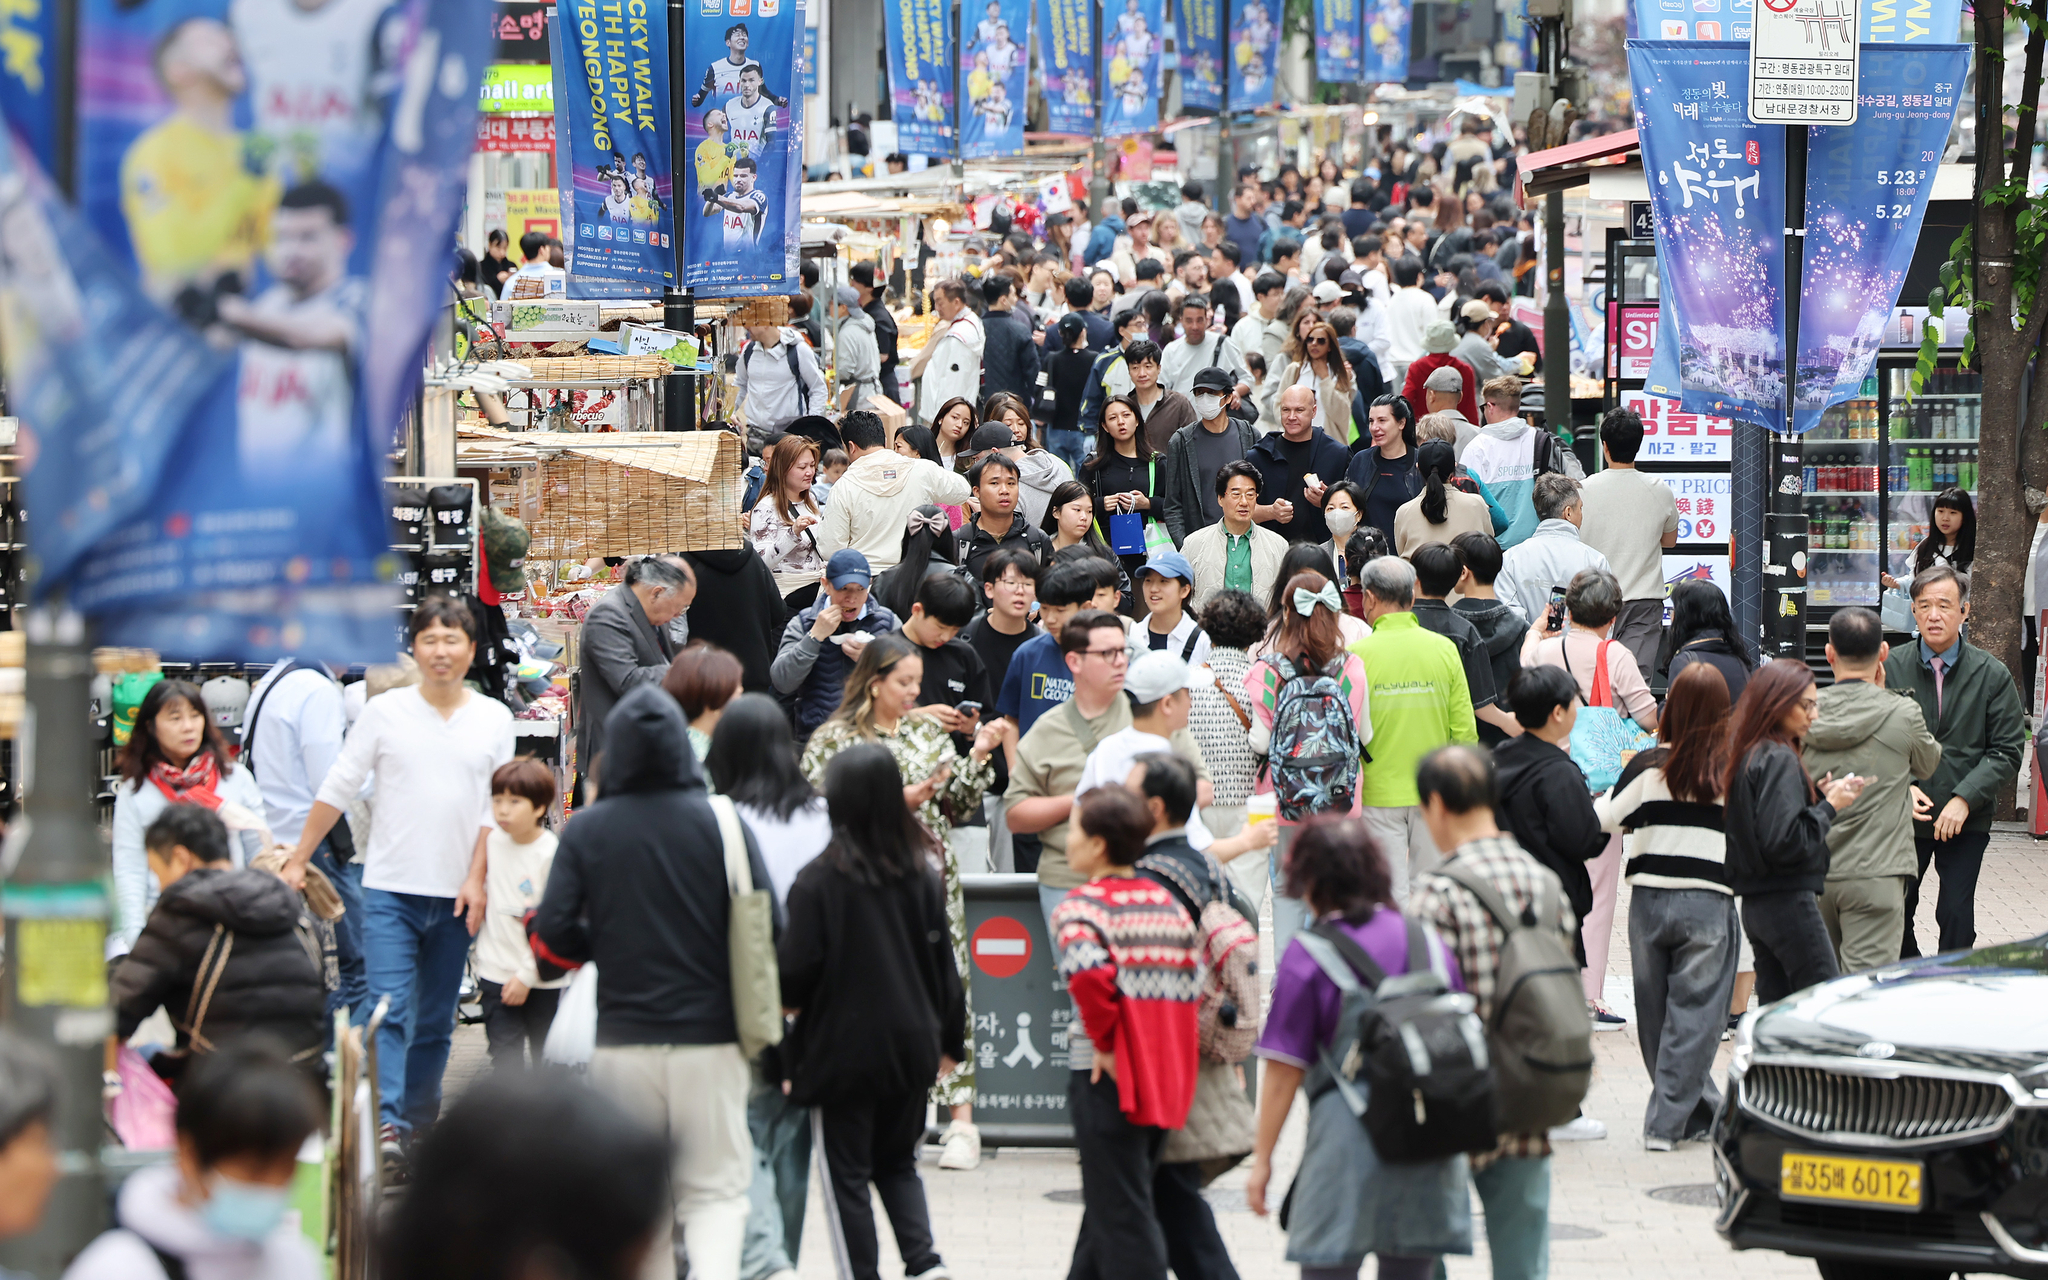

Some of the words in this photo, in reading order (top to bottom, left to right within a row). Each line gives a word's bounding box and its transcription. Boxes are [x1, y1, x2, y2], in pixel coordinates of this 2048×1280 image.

[1759, 62, 1776, 74] 구간
[1782, 63, 1832, 75] 명동관광특구
[1834, 63, 1850, 76] 일대
[606, 39, 633, 125] HAPPY
[1934, 82, 1953, 94] 중구
[480, 80, 518, 100] nail
[633, 58, 656, 132] WALK
[1758, 83, 1771, 94] 기간
[1806, 84, 1849, 96] 10:00~23:00
[1901, 94, 1933, 107] 정동길
[1934, 96, 1952, 108] 일대
[1765, 103, 1840, 115] 남대문경찰서장
[1872, 111, 1905, 121] Jung-gu
[1906, 111, 1951, 120] Jeong-dong
[733, 128, 759, 140] AIA
[1685, 138, 1743, 169] 정동
[1921, 151, 1935, 162] 20
[723, 215, 744, 229] AIA
[1625, 320, 1657, 350] SI
[1648, 442, 1675, 455] 사고
[1690, 442, 1717, 455] 팔고
[1498, 464, 1534, 478] SPORTSW
[1852, 1166, 1909, 1199] 6012
